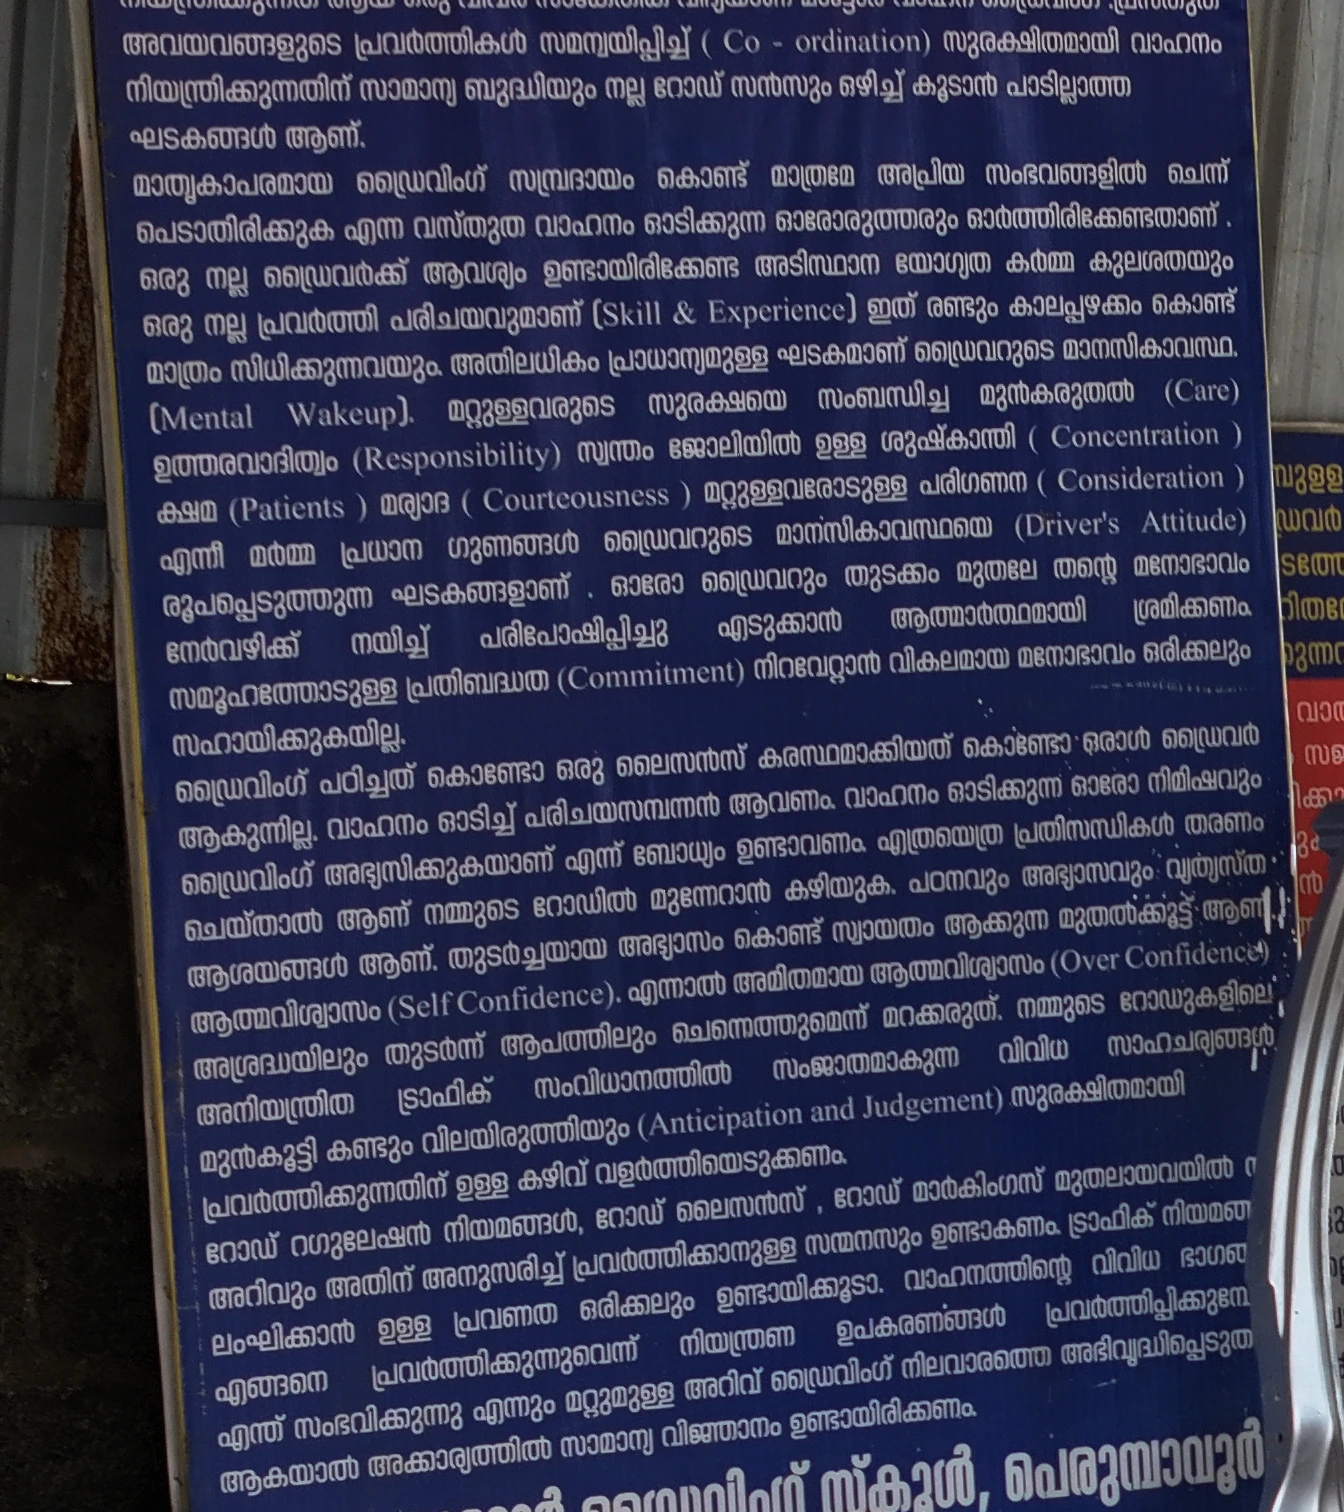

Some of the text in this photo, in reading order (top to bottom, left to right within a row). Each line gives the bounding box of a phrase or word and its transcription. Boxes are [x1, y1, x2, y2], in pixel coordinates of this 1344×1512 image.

[672, 299, 698, 325] &
[1164, 377, 1240, 408] (Care)
[1014, 509, 1120, 543] (Driver's
[1140, 506, 1247, 536] Attitude)
[557, 657, 745, 696] (Commitment)
[387, 990, 454, 1026] (Self
[456, 979, 623, 1015] Confidence).
[1050, 949, 1121, 979] (Over
[1125, 942, 1270, 969] Confidence)
[637, 1101, 804, 1143] (Anticipation
[810, 1095, 856, 1123] and
[862, 1085, 1004, 1122] Judgement)
